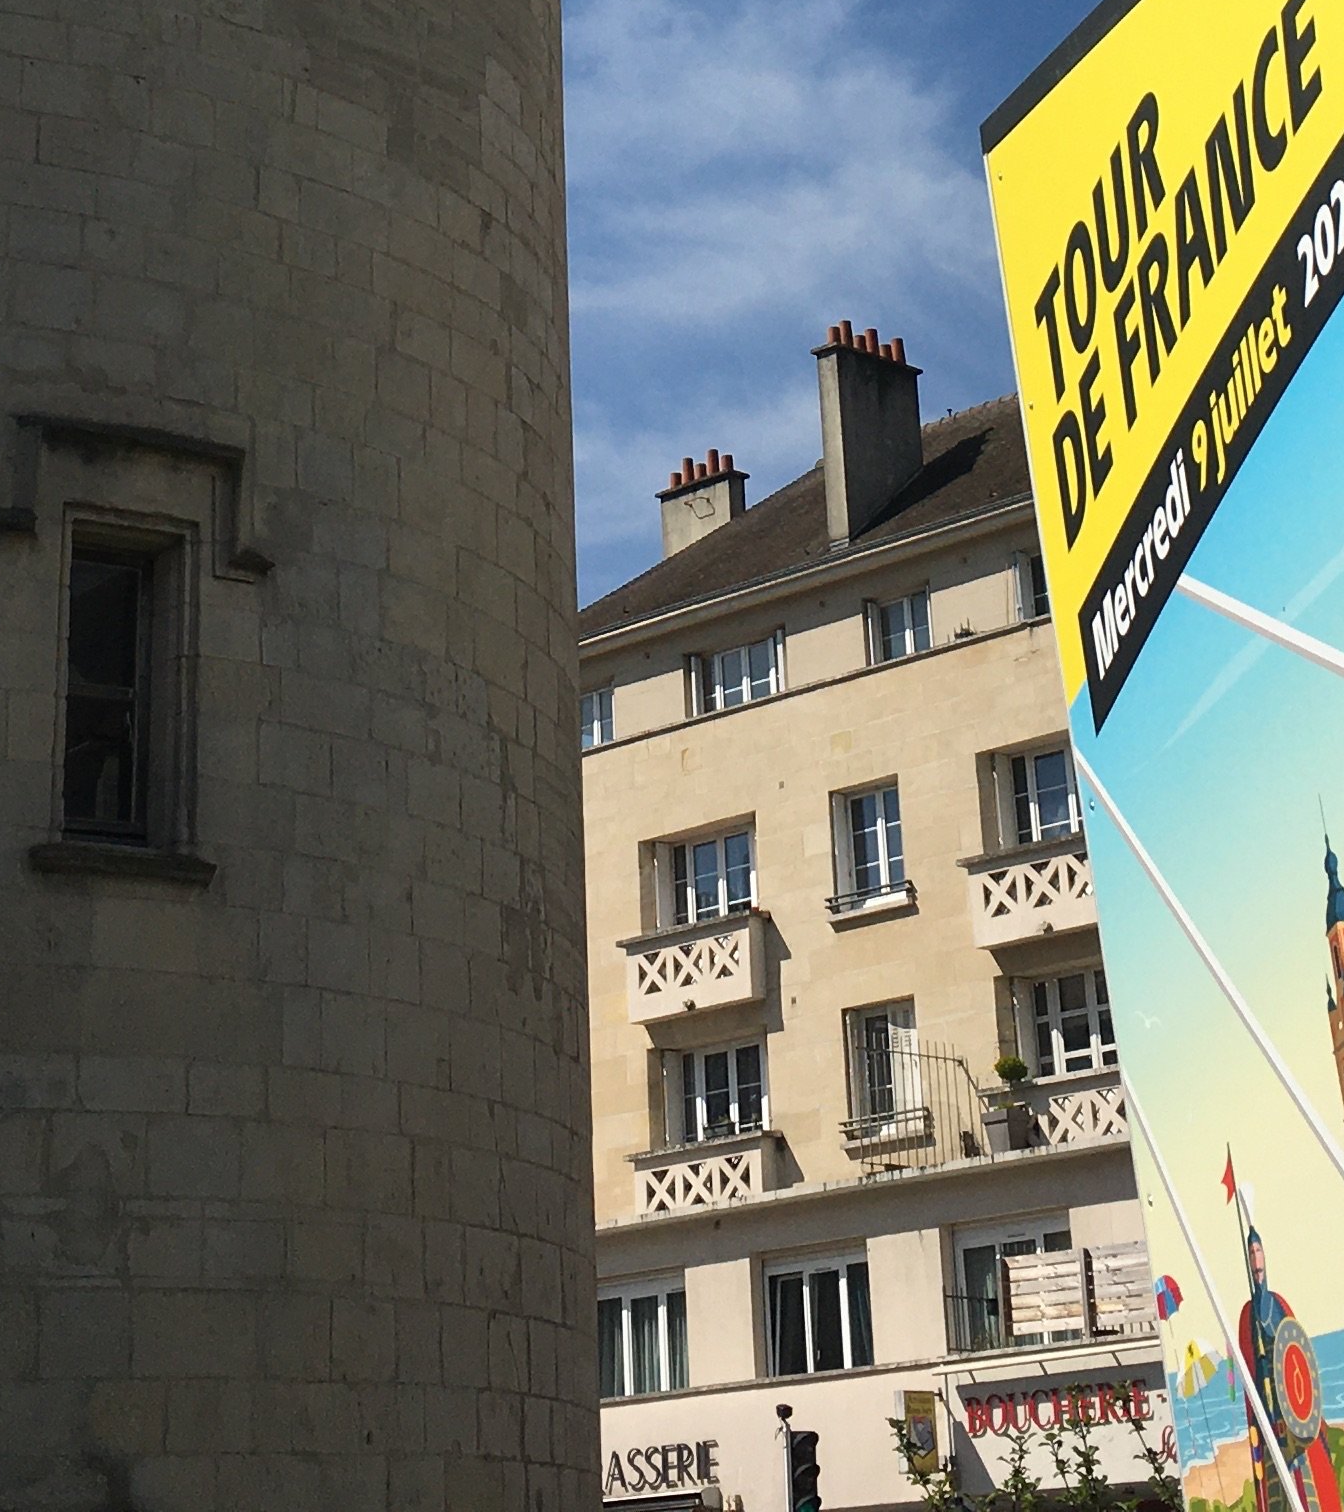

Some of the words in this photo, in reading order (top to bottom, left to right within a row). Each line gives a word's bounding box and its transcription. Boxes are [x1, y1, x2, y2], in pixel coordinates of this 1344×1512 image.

[1035, 91, 1165, 403] TOUR
[1052, 347, 1114, 552] DE
[1091, 448, 1191, 680] Mercredi
[1192, 419, 1208, 491] 9
[1211, 283, 1292, 485] juillet
